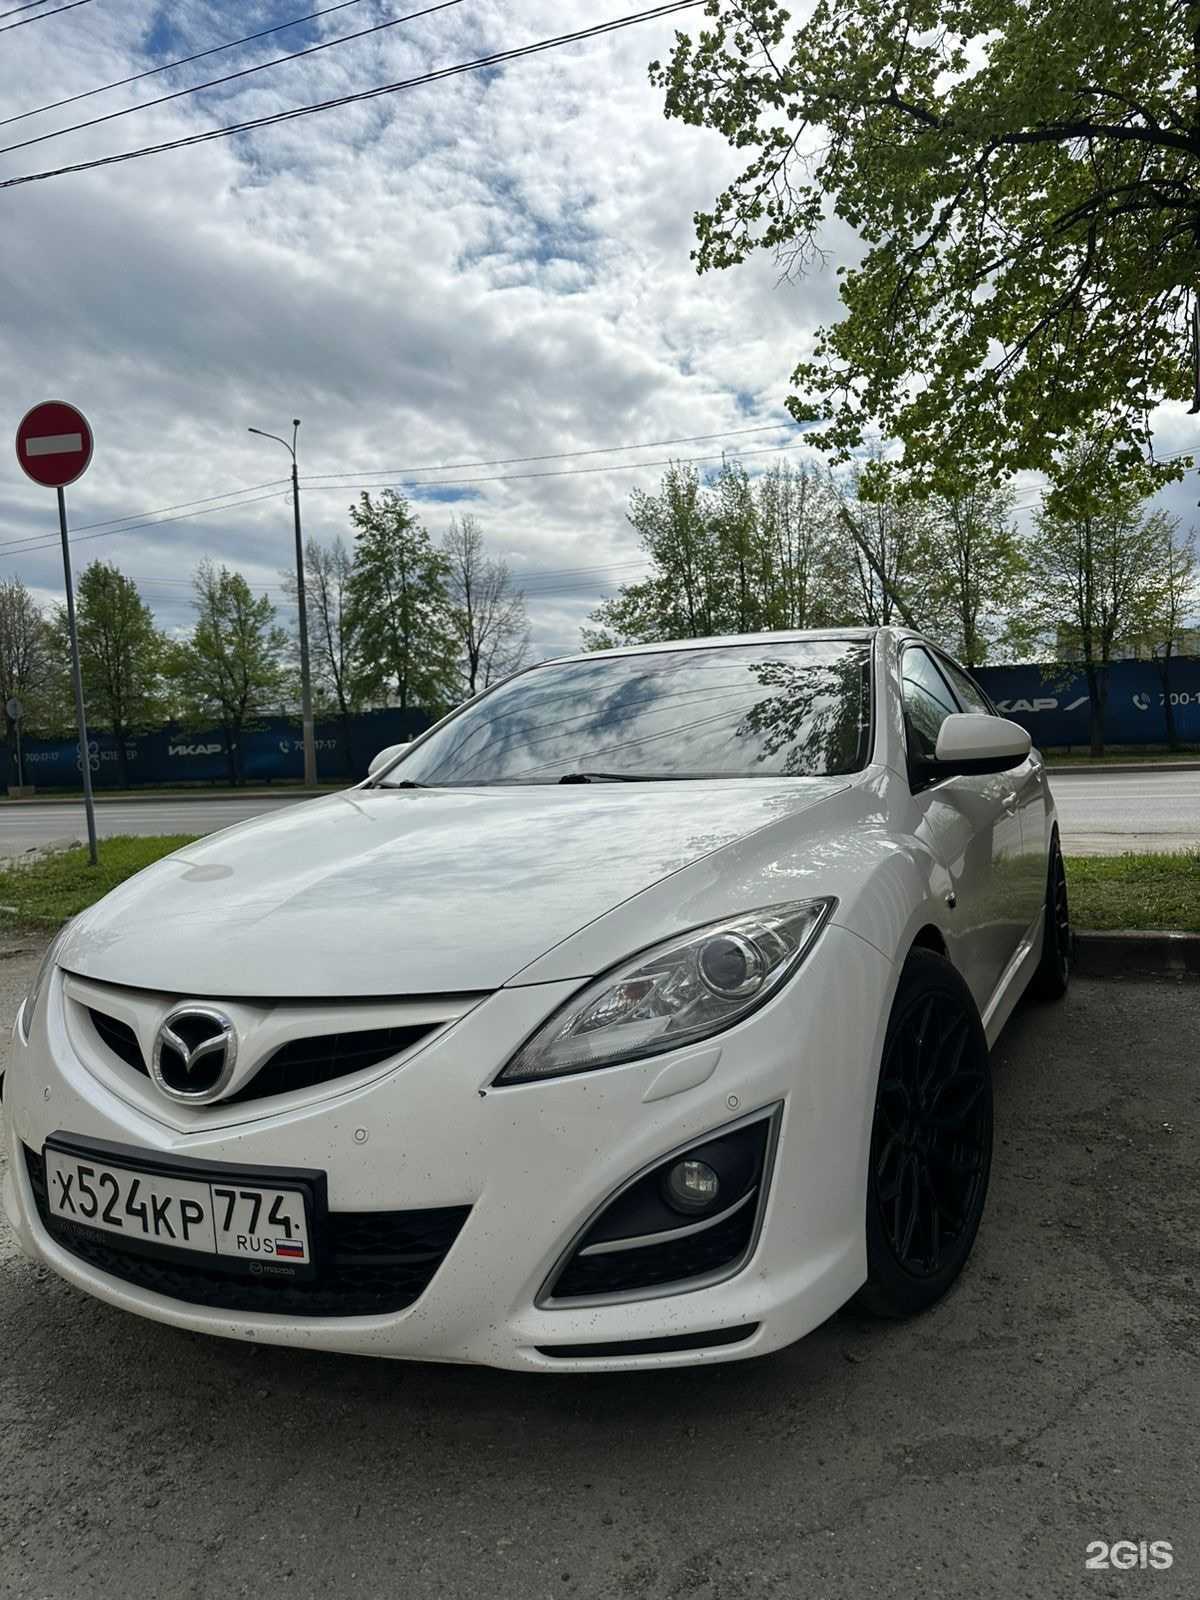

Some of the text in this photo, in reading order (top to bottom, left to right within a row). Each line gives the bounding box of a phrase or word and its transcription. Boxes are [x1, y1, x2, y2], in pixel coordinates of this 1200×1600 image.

[168, 744, 222, 756] ИКАР
[214, 1189, 292, 1239] 774
[236, 1235, 275, 1254] RUS
